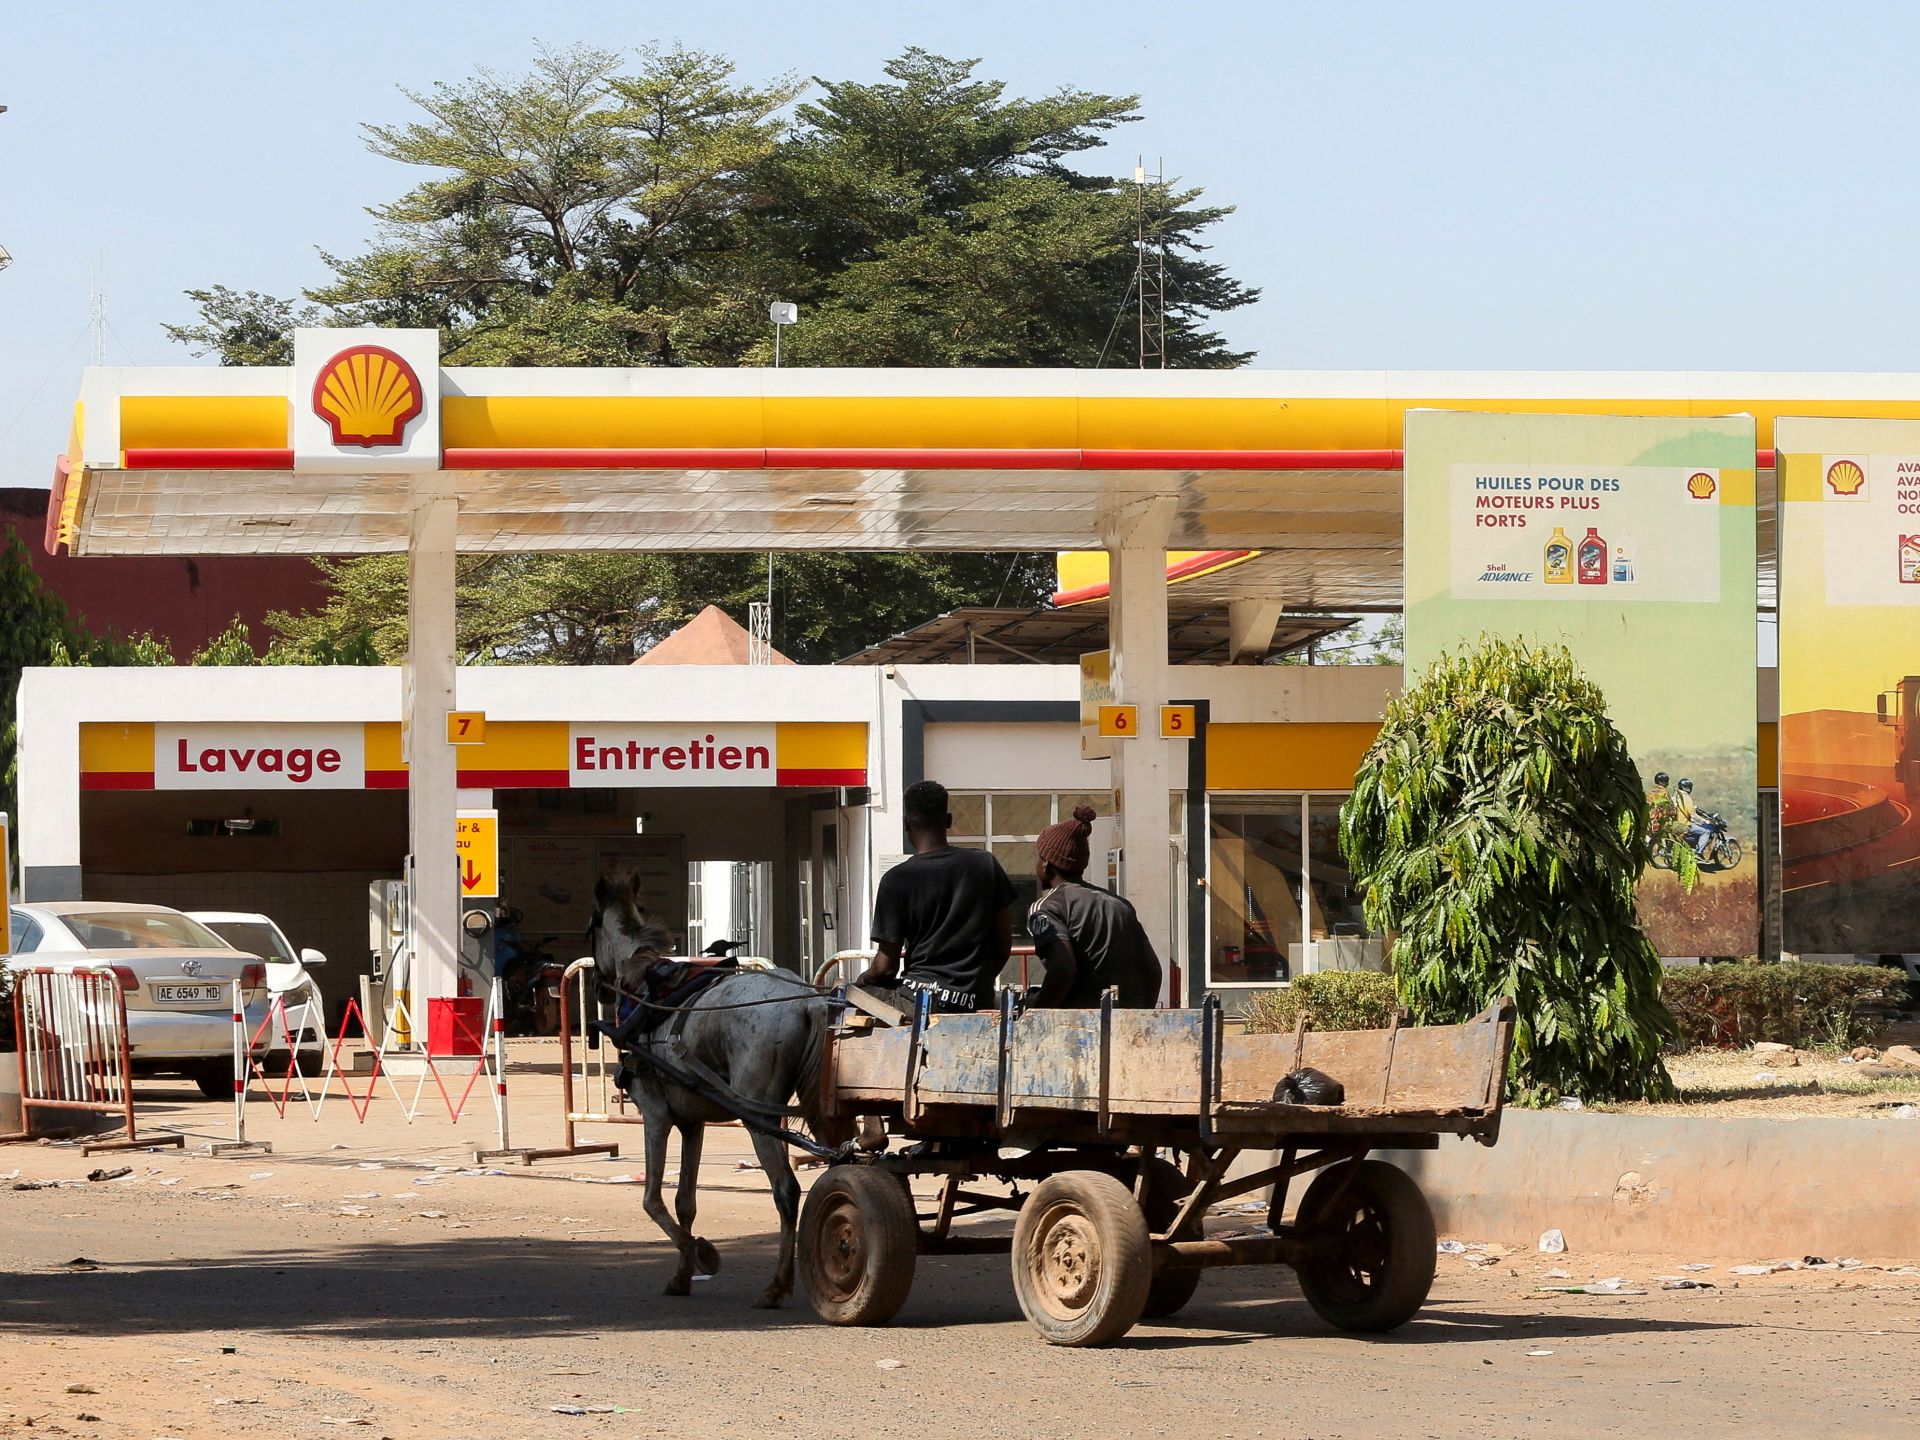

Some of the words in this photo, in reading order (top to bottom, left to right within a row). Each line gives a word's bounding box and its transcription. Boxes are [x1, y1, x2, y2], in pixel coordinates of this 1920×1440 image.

[1475, 476, 1532, 491] HUILES
[1538, 477, 1584, 491] POUR
[1590, 478, 1620, 492] DES
[1475, 495, 1555, 510] MOTEURS
[1560, 496, 1600, 510] PLUS
[1898, 490, 1920, 501] NO
[1476, 514, 1527, 528] FORTS
[1486, 563, 1507, 572] Shell
[1477, 572, 1534, 582] ADVANCE
[457, 718, 471, 735] 7
[1114, 713, 1127, 729] 6
[1170, 713, 1183, 730] 5
[576, 734, 770, 771] Entretien
[177, 738, 342, 783] Lavage
[456, 822, 467, 833] ir
[471, 822, 480, 833] &
[160, 987, 173, 999] AE
[176, 987, 200, 999] 6549
[206, 987, 218, 998] MD
[940, 988, 976, 1009] BUDS
